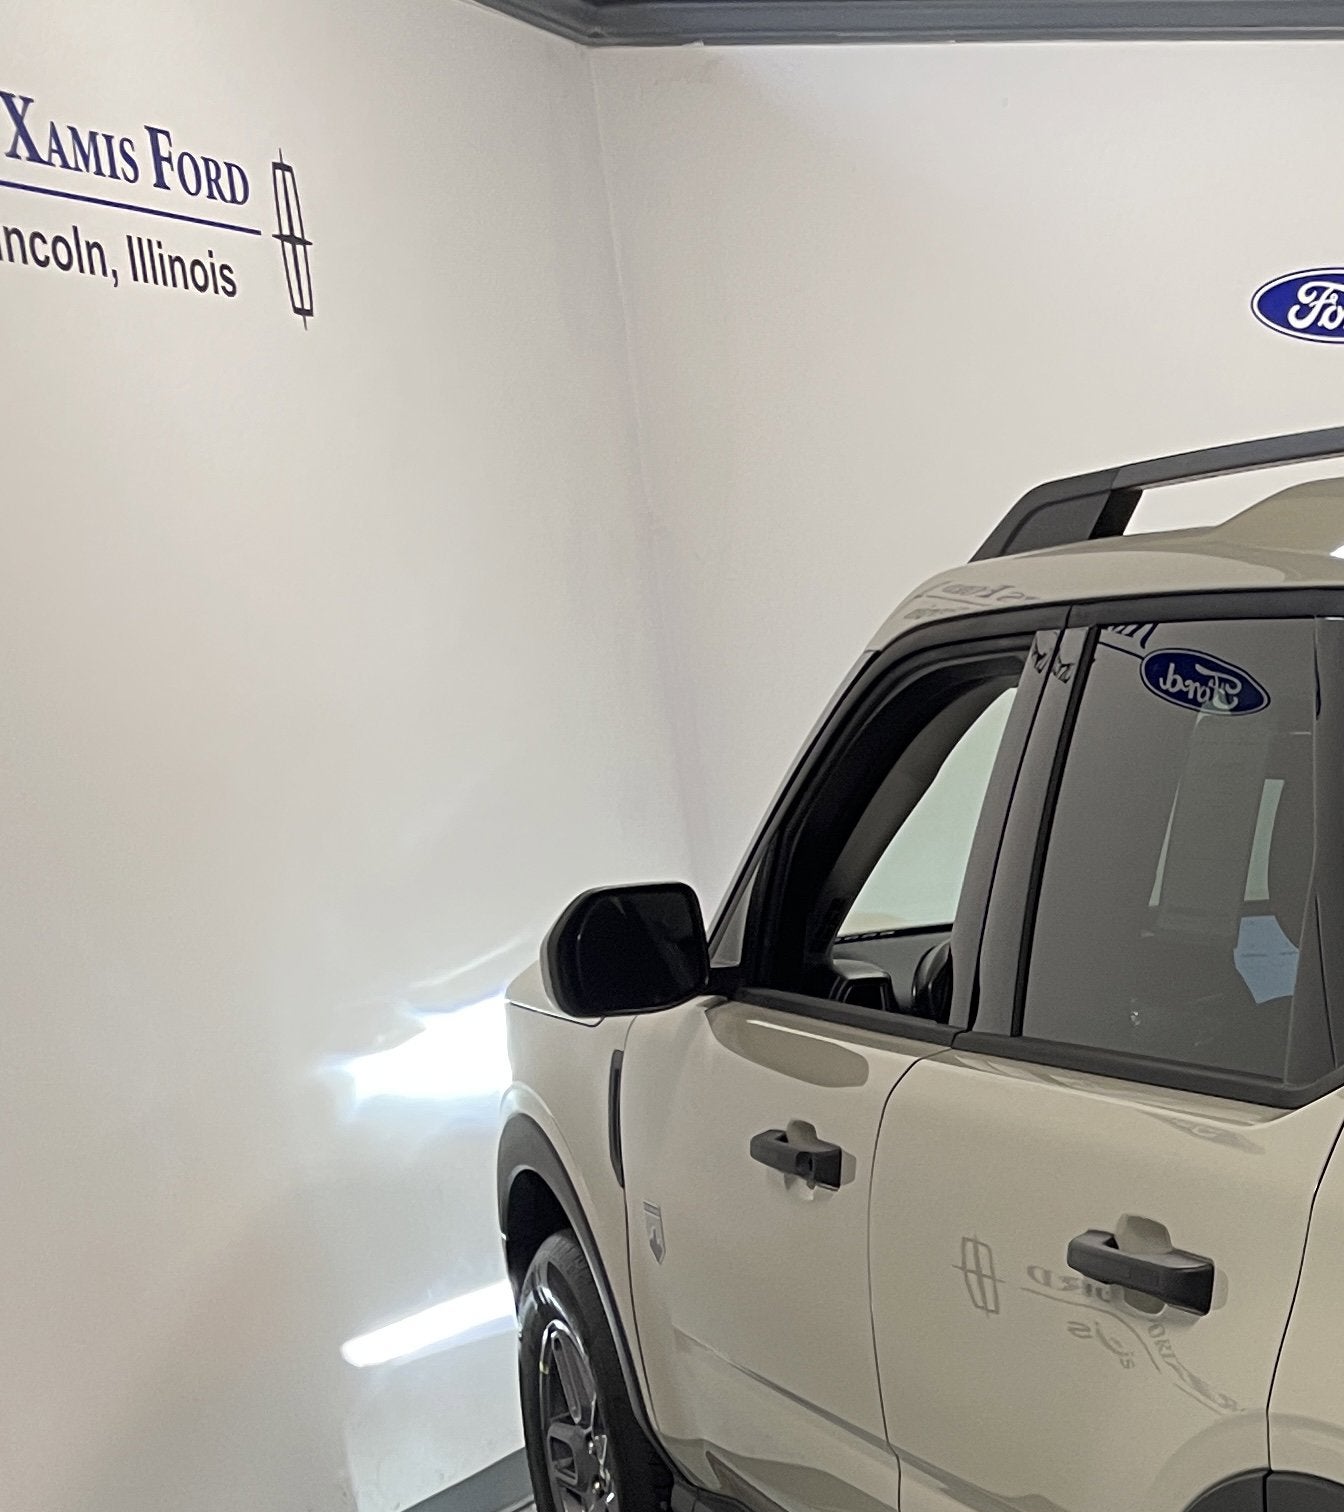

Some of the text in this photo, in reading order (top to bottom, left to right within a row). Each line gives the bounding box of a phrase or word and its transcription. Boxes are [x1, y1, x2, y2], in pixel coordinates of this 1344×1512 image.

[0, 90, 250, 206] XAMIS FORD
[0, 225, 238, 298] ncoln, Illinois
